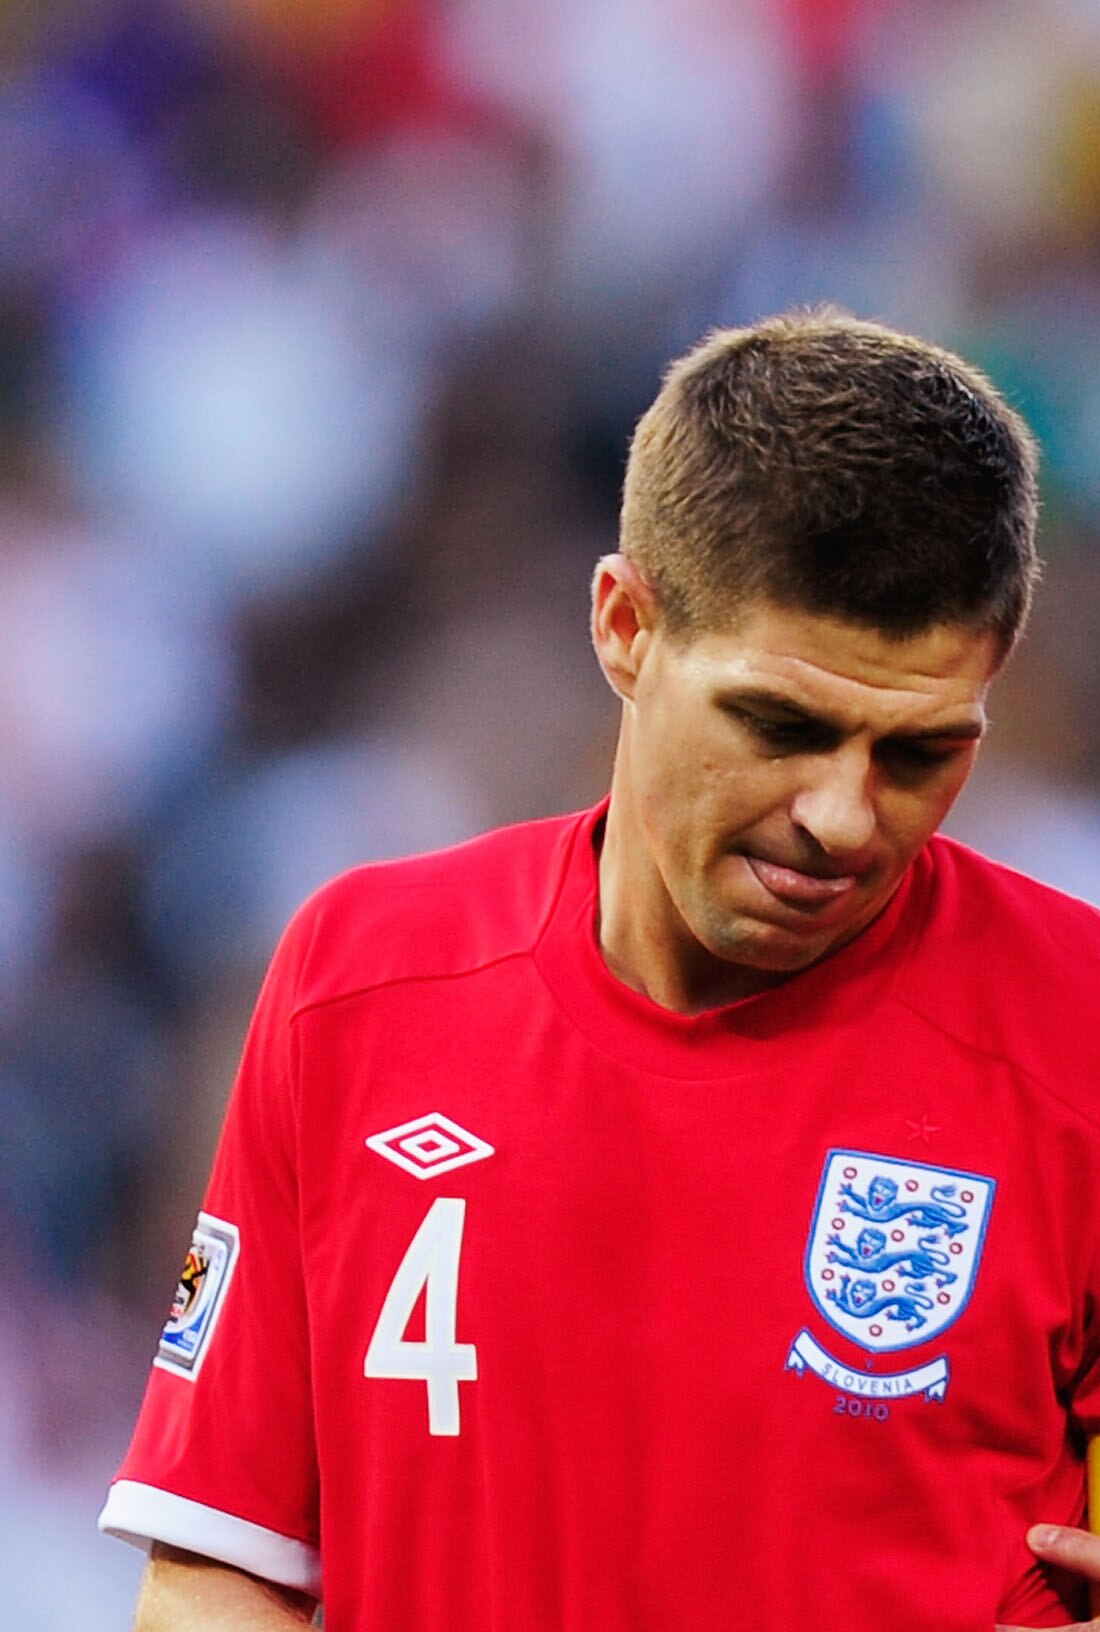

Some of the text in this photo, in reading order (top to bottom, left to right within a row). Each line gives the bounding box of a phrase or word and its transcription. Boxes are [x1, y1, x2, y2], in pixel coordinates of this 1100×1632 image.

[364, 1198, 477, 1437] 4
[821, 1363, 913, 1394] SLOVENIA
[833, 1396, 889, 1420] 2010
